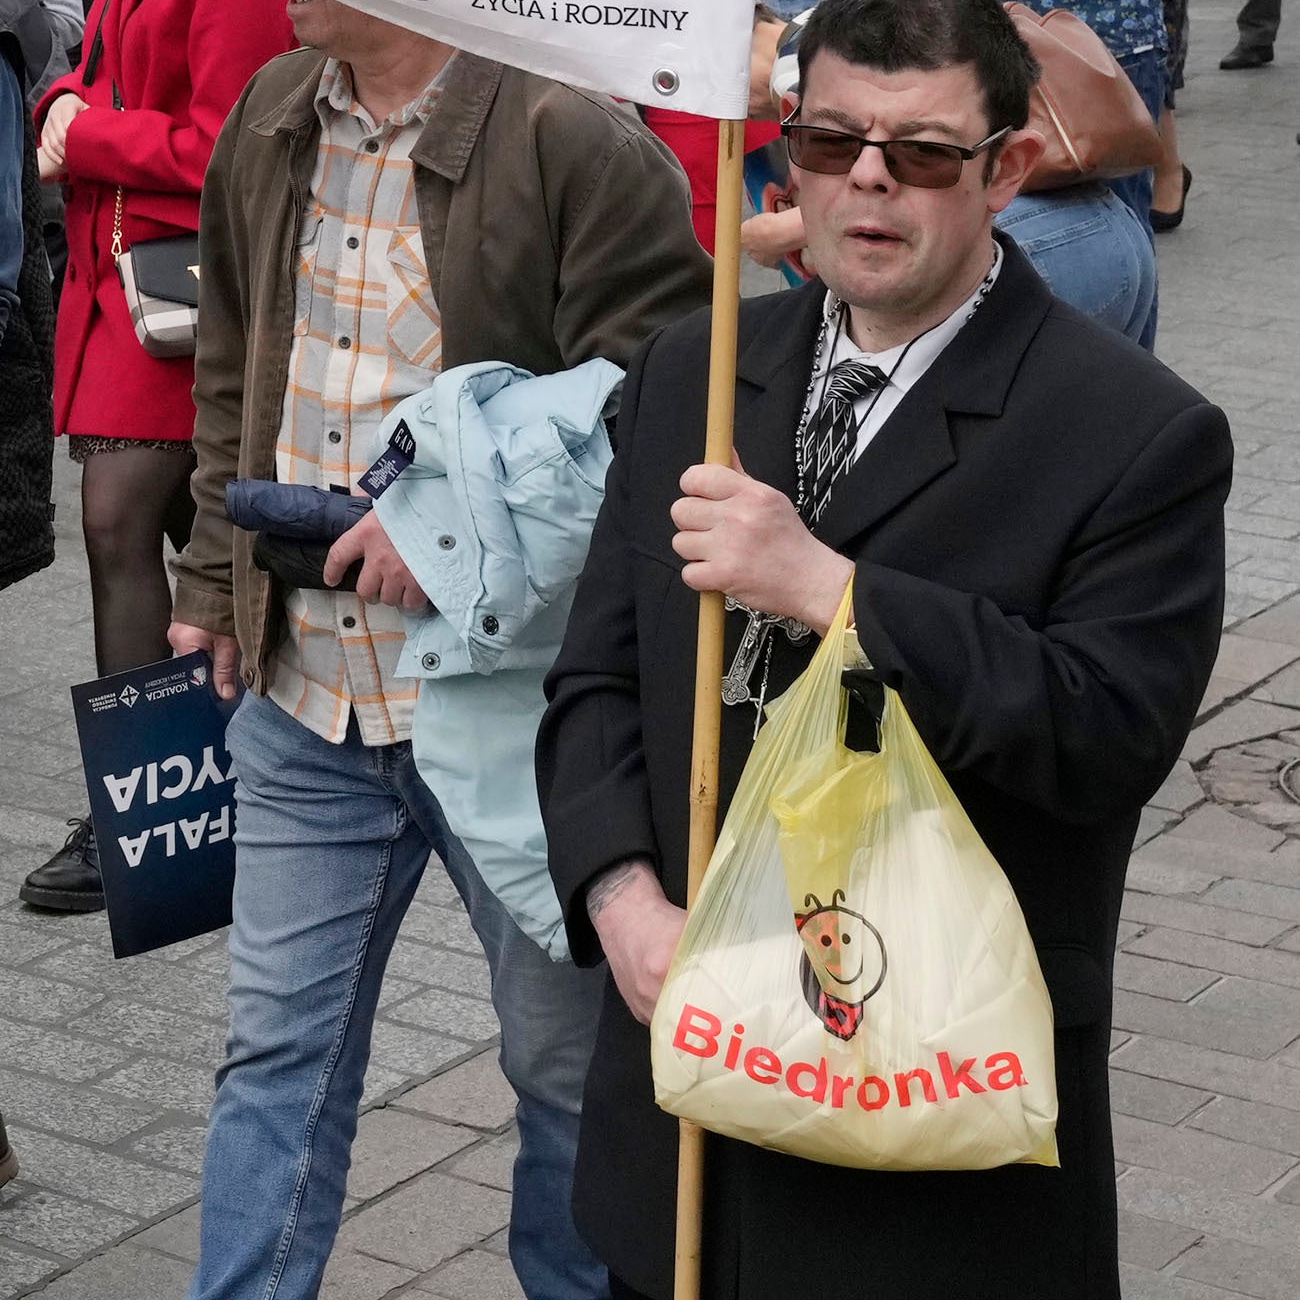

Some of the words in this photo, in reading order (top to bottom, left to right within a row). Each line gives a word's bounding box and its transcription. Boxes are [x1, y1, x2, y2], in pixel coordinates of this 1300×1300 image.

[551, 1, 559, 22] i
[564, 2, 689, 31] RODZINY
[394, 427, 414, 454] GAP
[144, 682, 189, 702] KOALICJA
[102, 745, 237, 813] YCIA
[672, 1002, 1030, 1112] Biedronka
